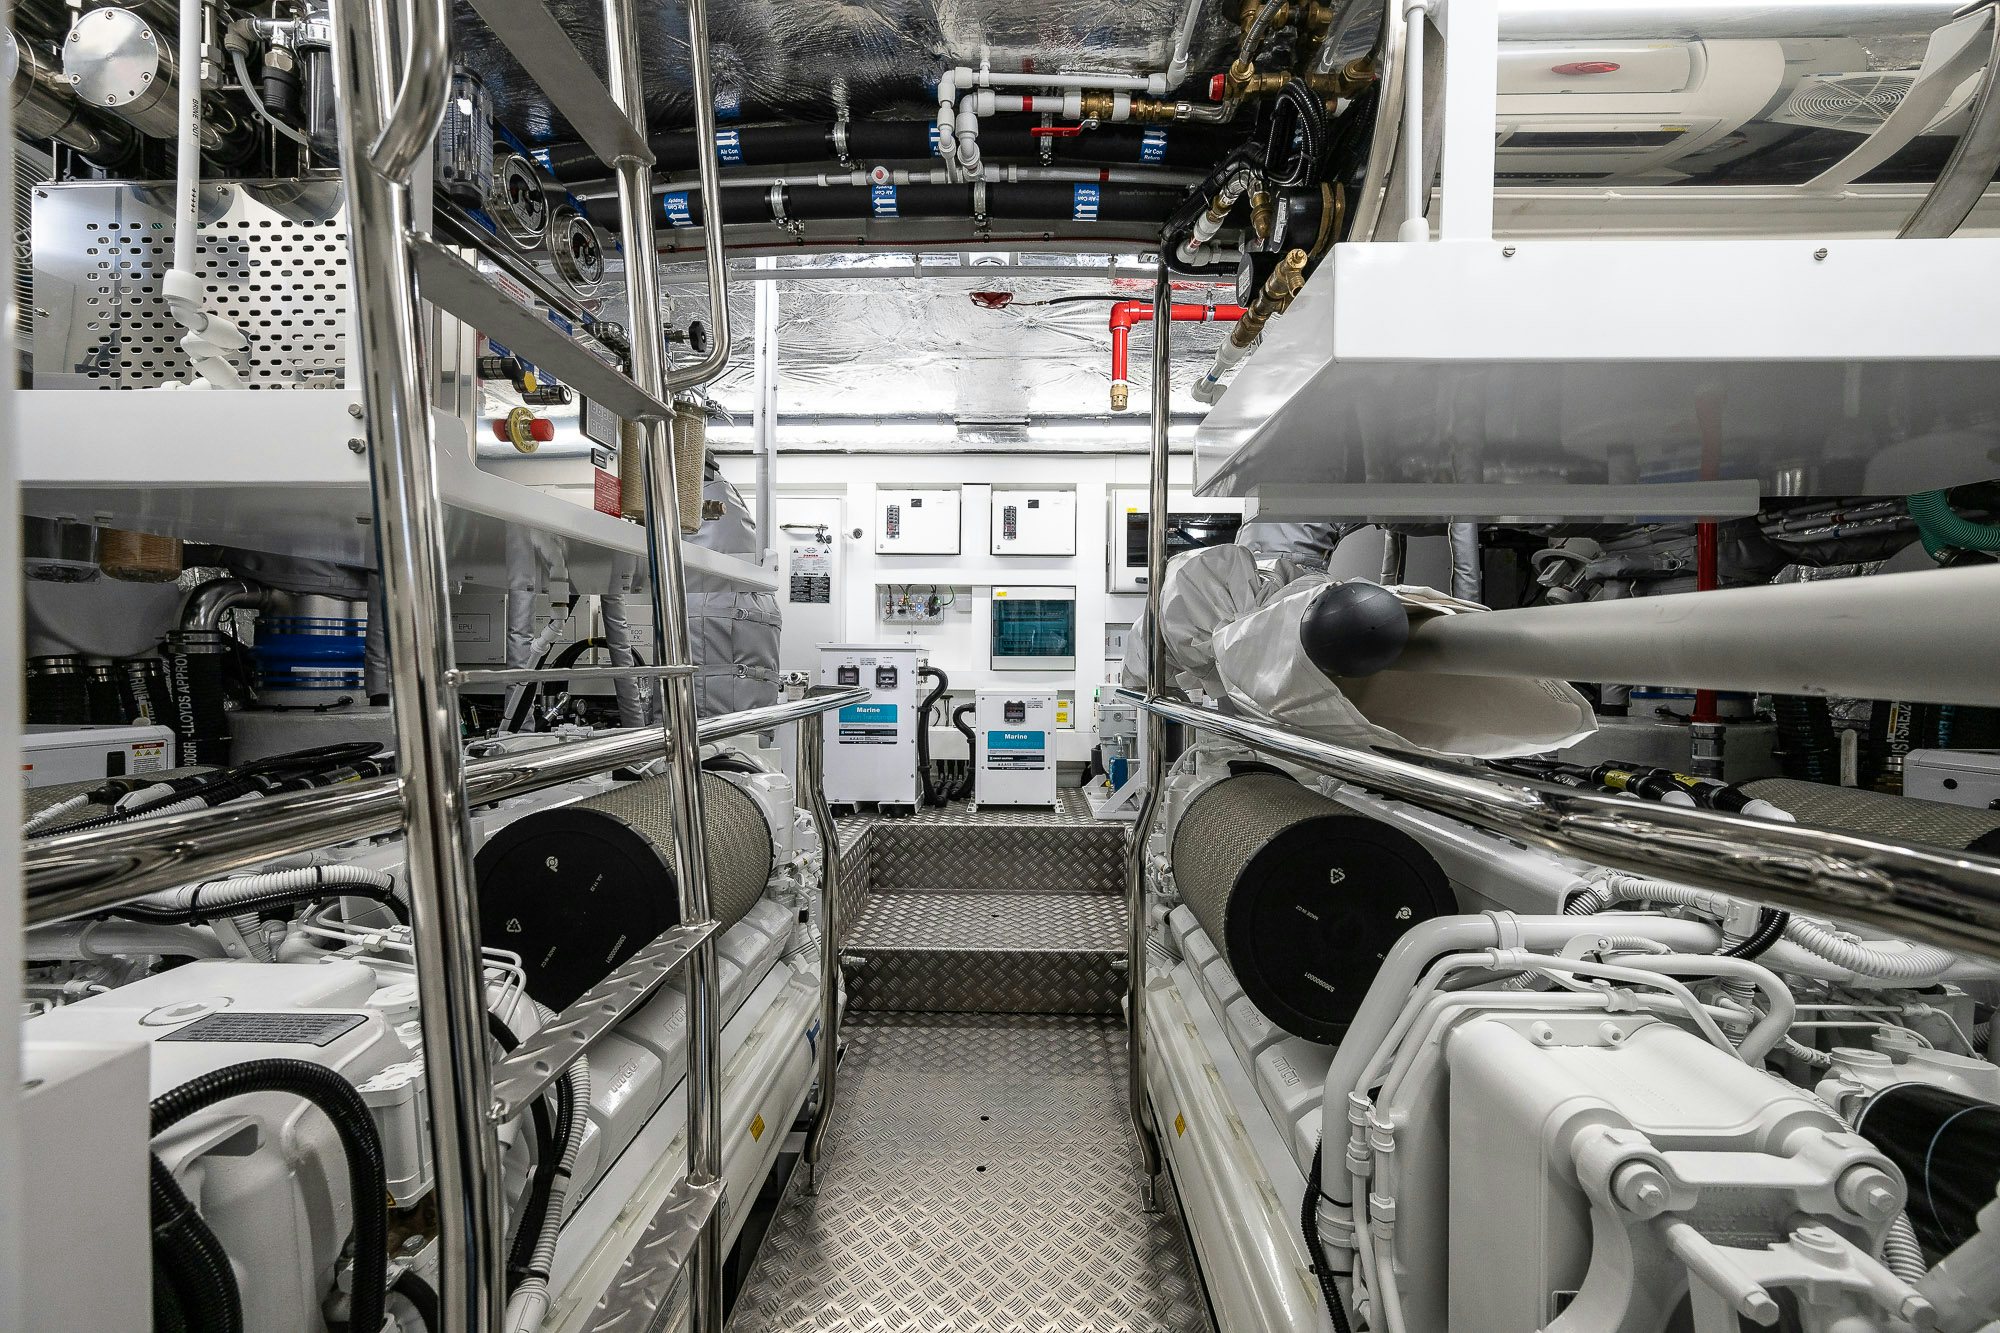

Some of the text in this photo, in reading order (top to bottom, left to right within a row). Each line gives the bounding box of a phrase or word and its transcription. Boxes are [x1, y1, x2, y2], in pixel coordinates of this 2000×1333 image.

[1239, 1005, 1263, 1029] mtu
[607, 1058, 640, 1093] mtu
[1271, 1056, 1300, 1088] mtu
